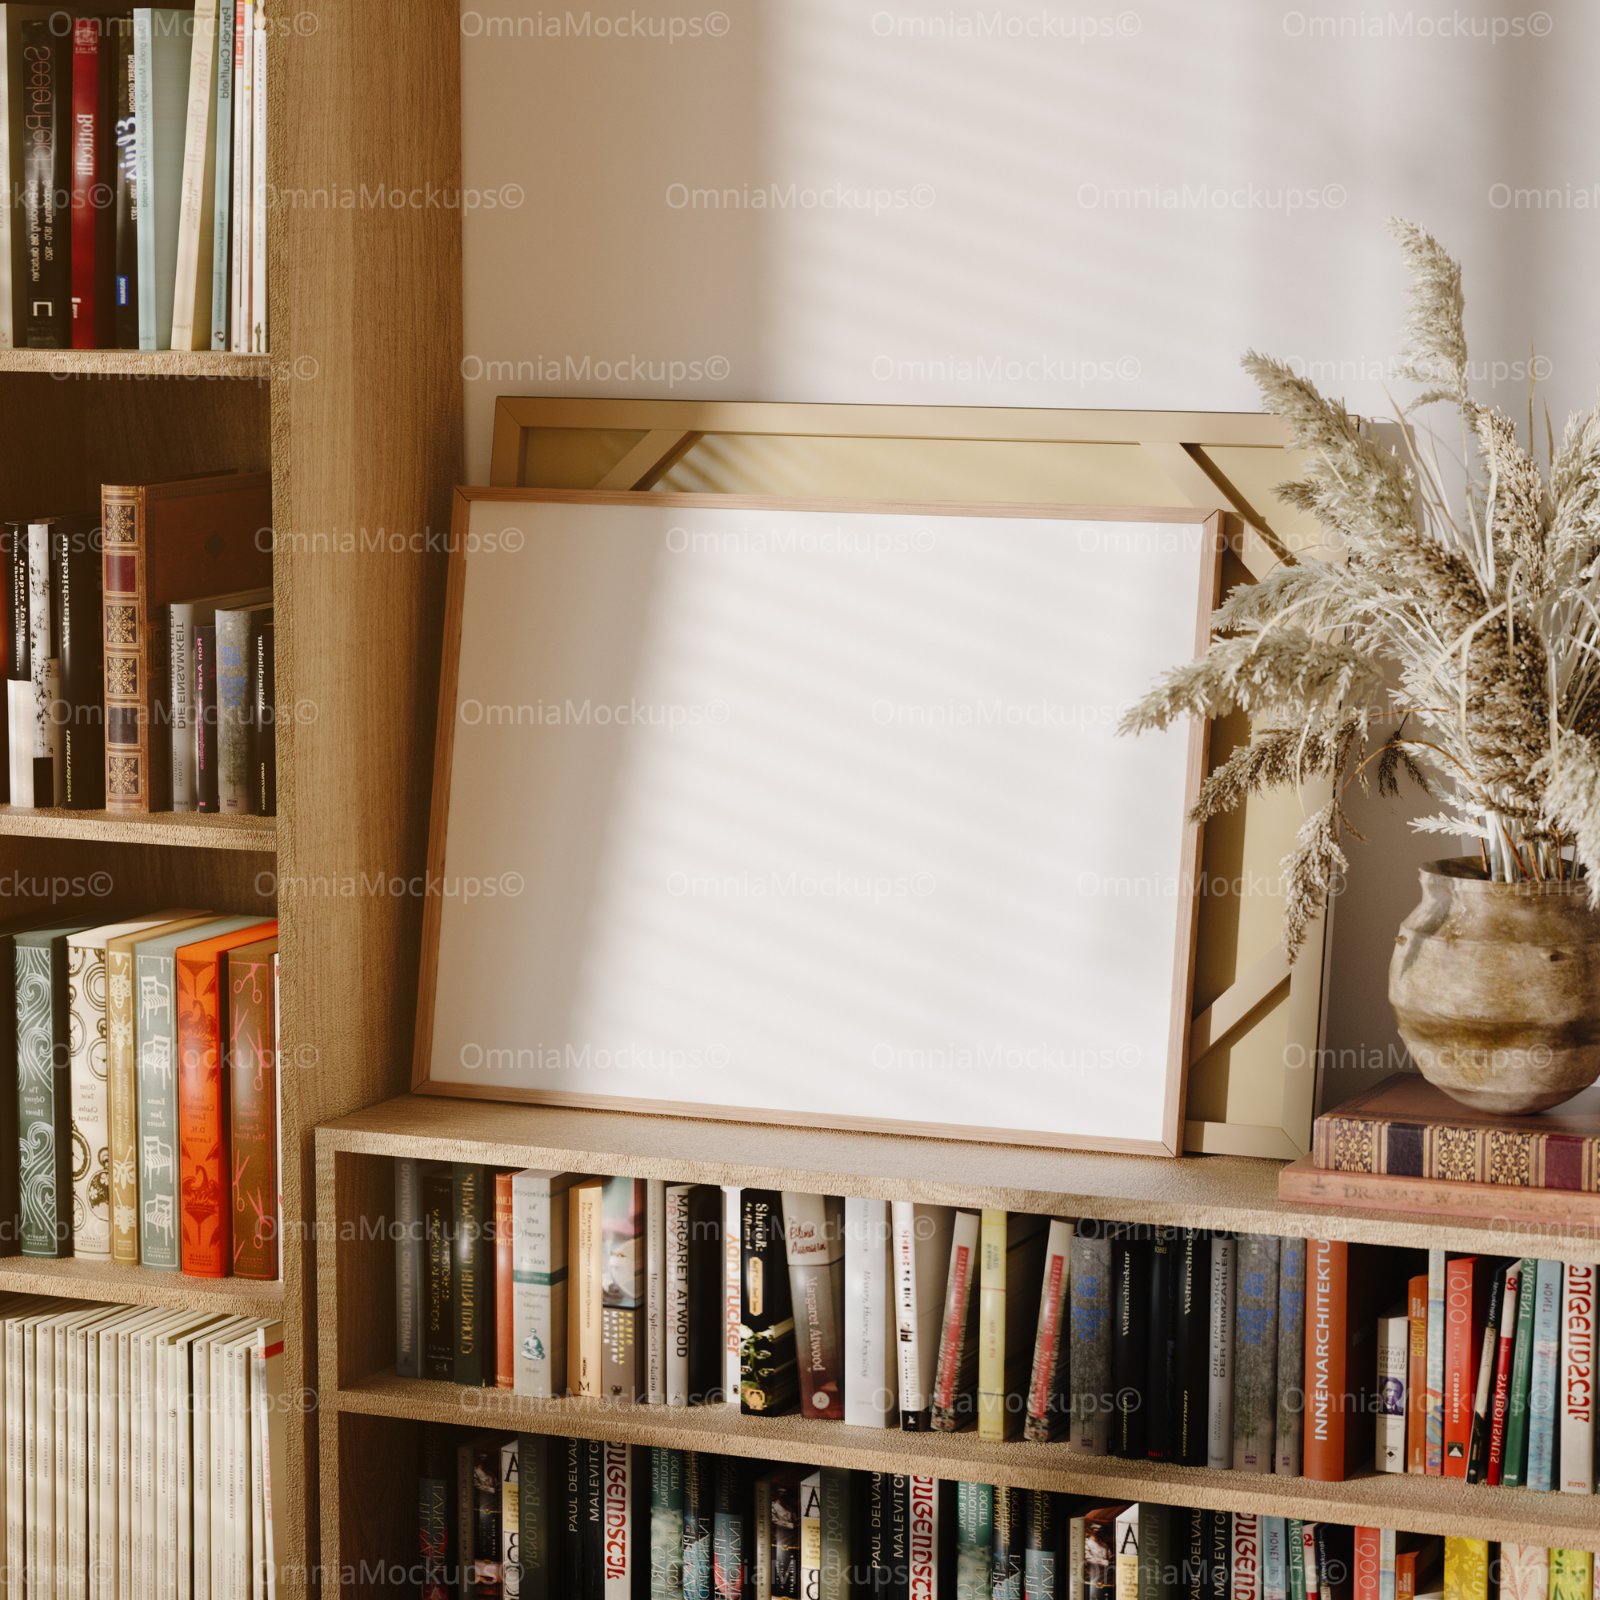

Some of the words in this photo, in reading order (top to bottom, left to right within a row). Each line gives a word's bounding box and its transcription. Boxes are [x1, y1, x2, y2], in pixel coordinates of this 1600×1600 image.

[62, 535, 71, 648] Weltarchitektur
[667, 1194, 677, 1235] ORYX
[677, 1194, 688, 1285] MARGARET
[667, 1241, 677, 1273] AND
[401, 1288, 411, 1352] KLOSTERMAN
[667, 1280, 677, 1335] CRAKE
[804, 1276, 819, 1325] Margaret
[1122, 1251, 1130, 1336] Weltarchitektur
[1213, 1260, 1221, 1350] EINSAMKEIT
[1219, 1247, 1228, 1348] PRIMZAHLEN
[677, 1289, 688, 1358] ATWOOD
[810, 1328, 826, 1371] Atwood
[1315, 1239, 1330, 1440] INNENARCHITEKTU
[568, 1497, 578, 1532] PAUL
[871, 1533, 881, 1569] PAUL
[1269, 1531, 1278, 1562] MONET
[1360, 1537, 1376, 1590] 1900
